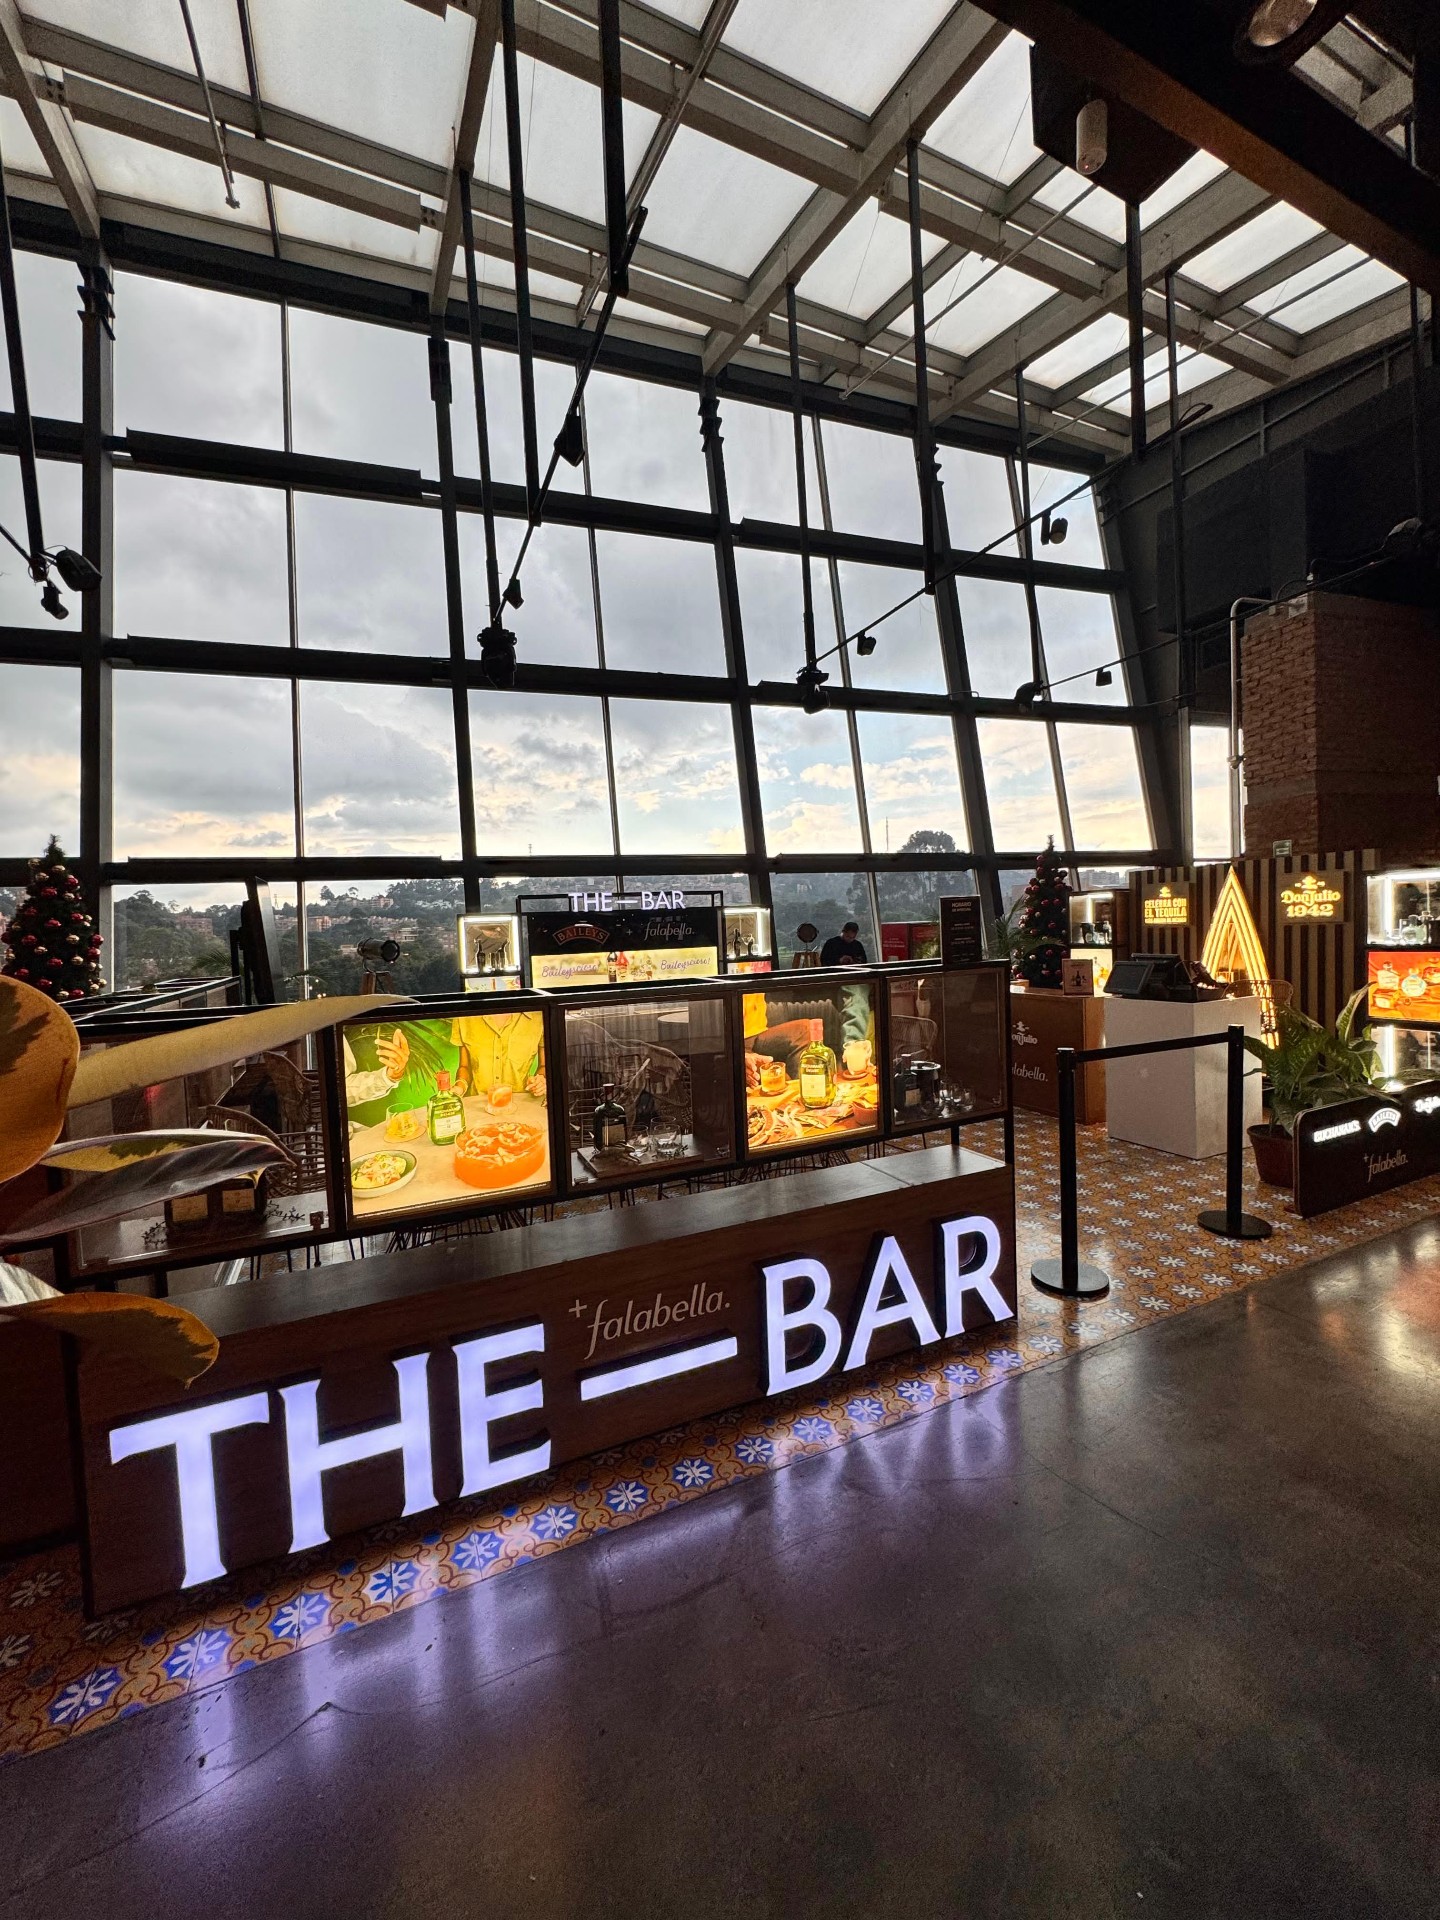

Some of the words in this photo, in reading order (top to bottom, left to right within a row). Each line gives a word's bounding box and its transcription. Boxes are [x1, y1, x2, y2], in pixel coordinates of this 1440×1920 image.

[568, 892, 613, 912] THE
[641, 890, 686, 911] BAR
[1173, 898, 1186, 907] CON
[1145, 908, 1154, 917] EL
[1155, 907, 1187, 917] TEQUILA
[1286, 903, 1334, 917] 1942
[557, 927, 605, 941] BAILEYS
[109, 1323, 551, 1589] THE
[762, 1215, 1015, 1396] BAR
